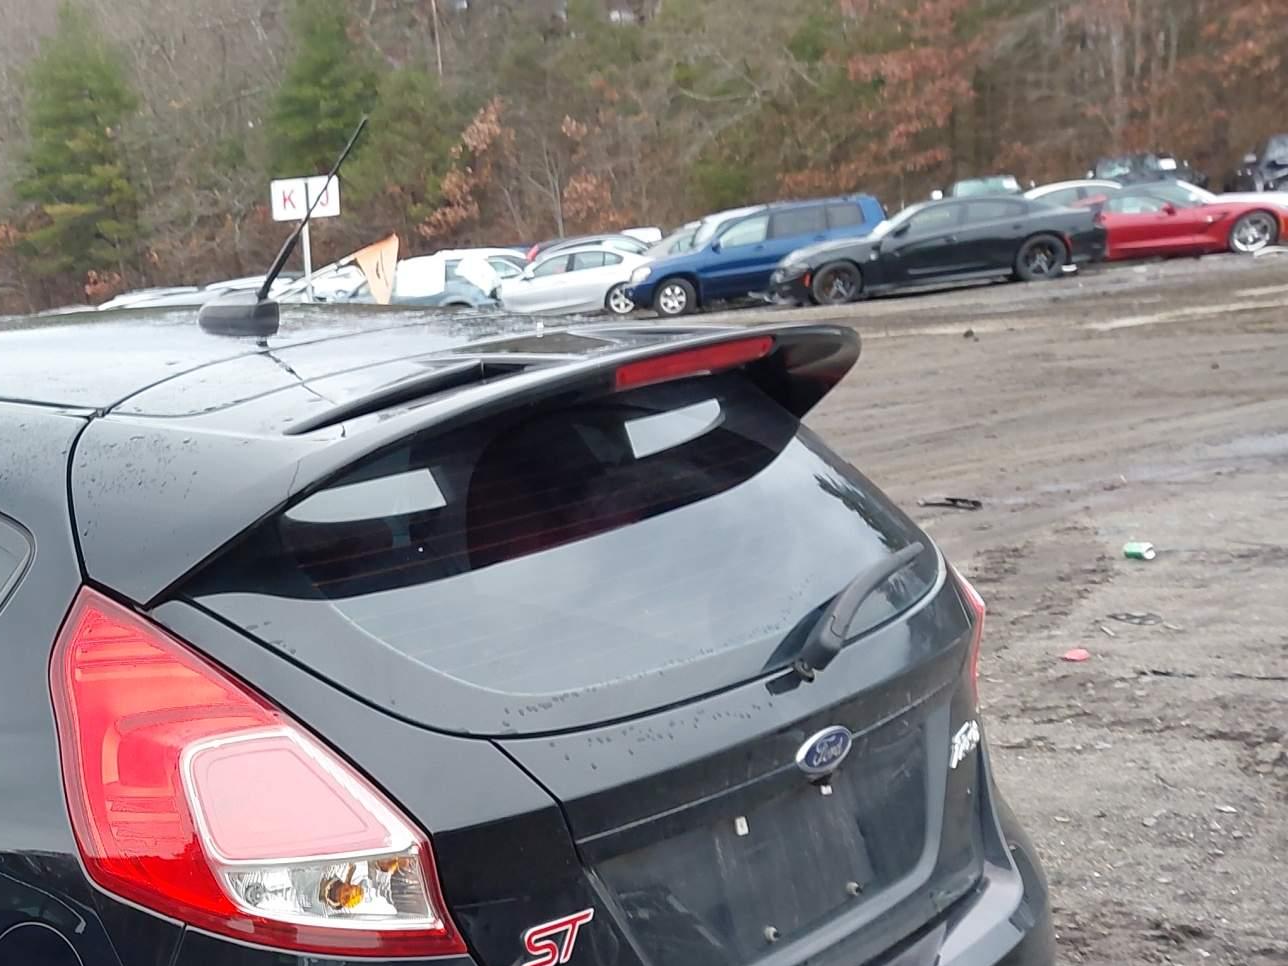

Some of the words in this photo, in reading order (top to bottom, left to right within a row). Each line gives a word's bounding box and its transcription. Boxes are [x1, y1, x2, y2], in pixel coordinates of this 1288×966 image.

[282, 189, 296, 209] K
[319, 187, 329, 207] J
[812, 735, 844, 767] Ford
